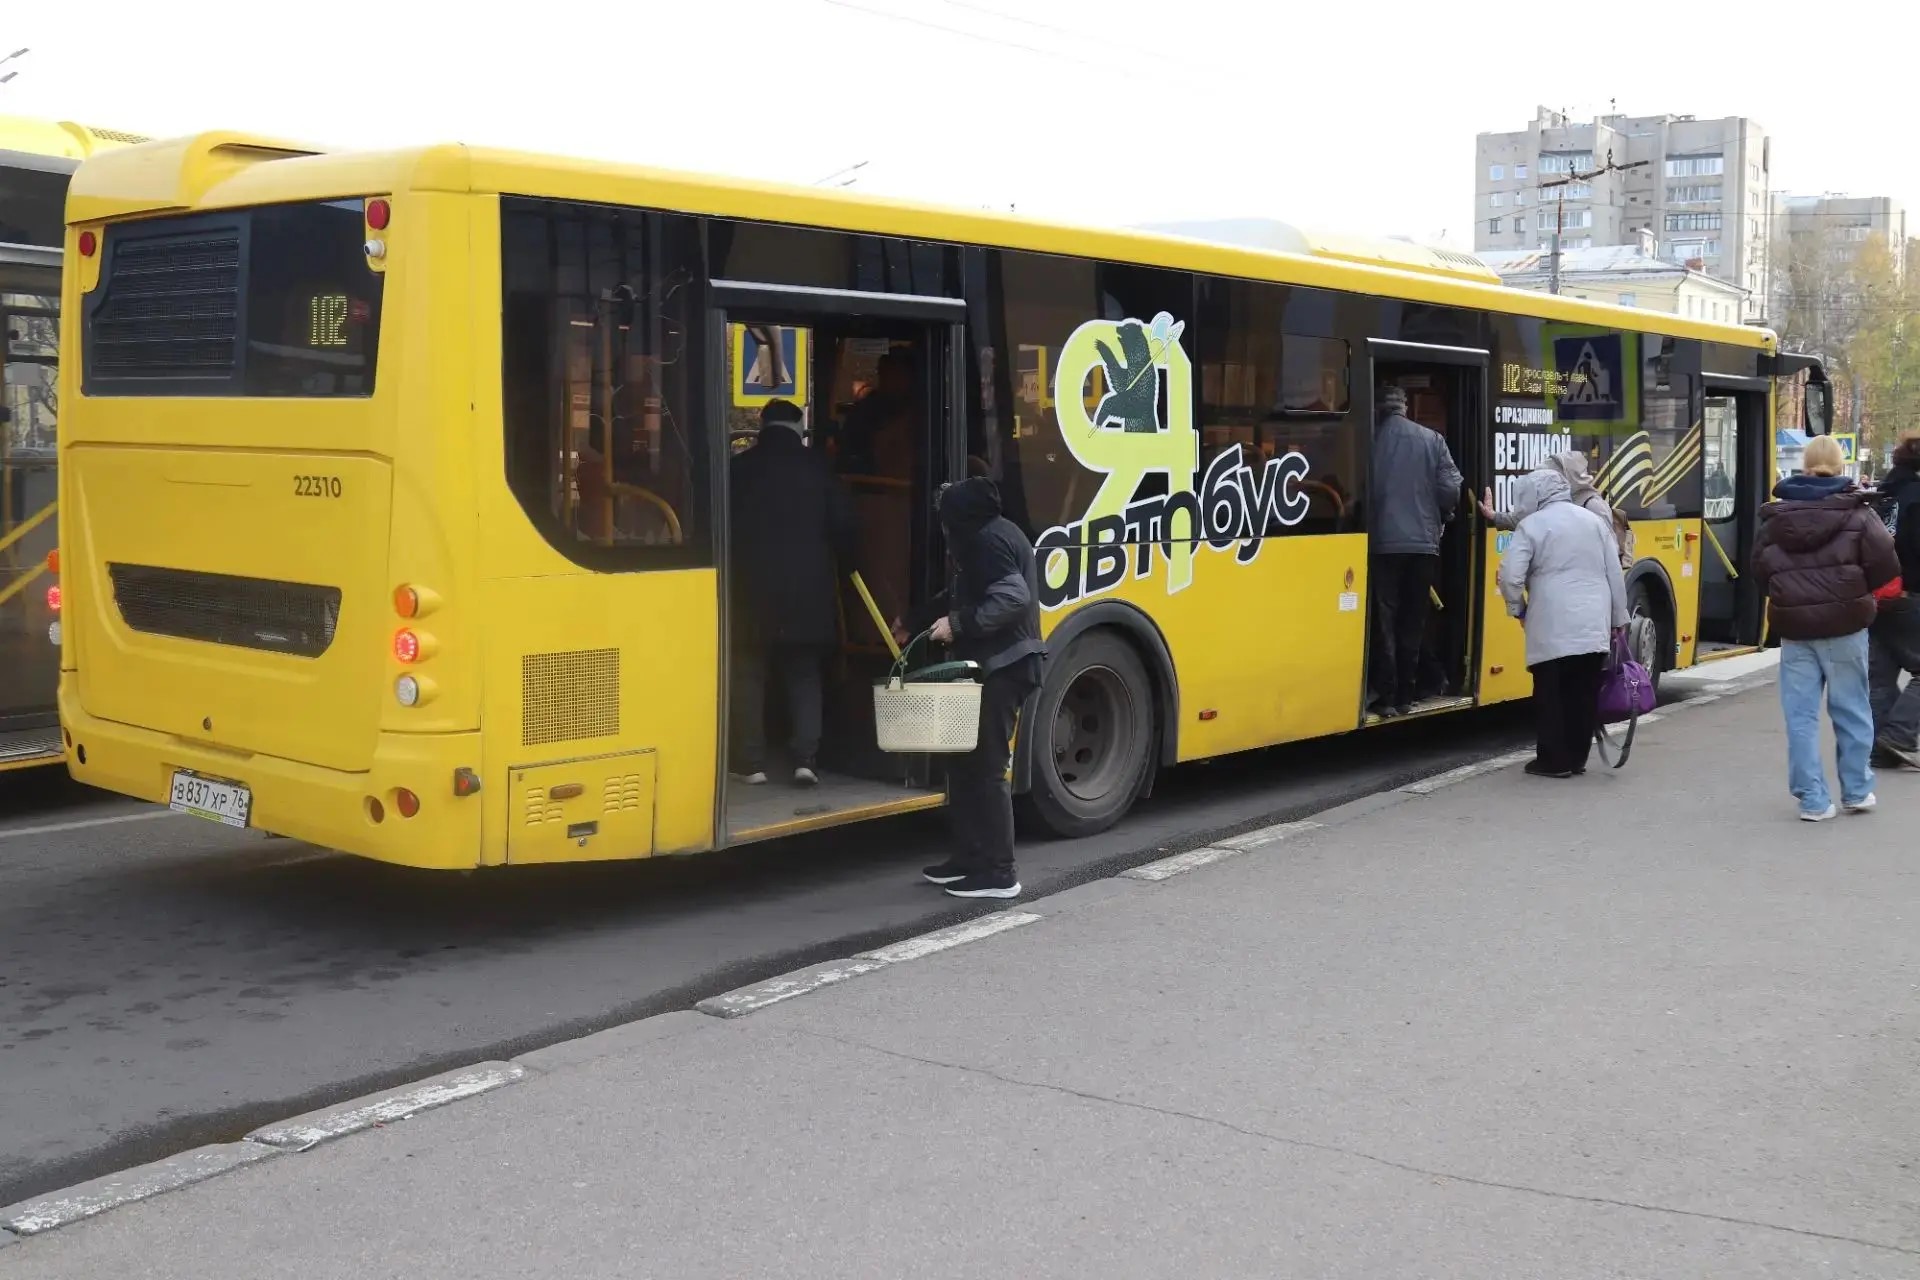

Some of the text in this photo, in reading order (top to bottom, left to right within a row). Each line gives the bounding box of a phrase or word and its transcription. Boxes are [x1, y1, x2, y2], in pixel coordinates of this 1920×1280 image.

[310, 295, 348, 345] 102
[1502, 363, 1520, 393] 102
[1494, 406, 1553, 427] С ПРАЗДНИКОМ
[1055, 313, 1199, 594] Я
[293, 474, 342, 498] 22310
[1034, 443, 1311, 612] автобус
[231, 789, 244, 809] 76
